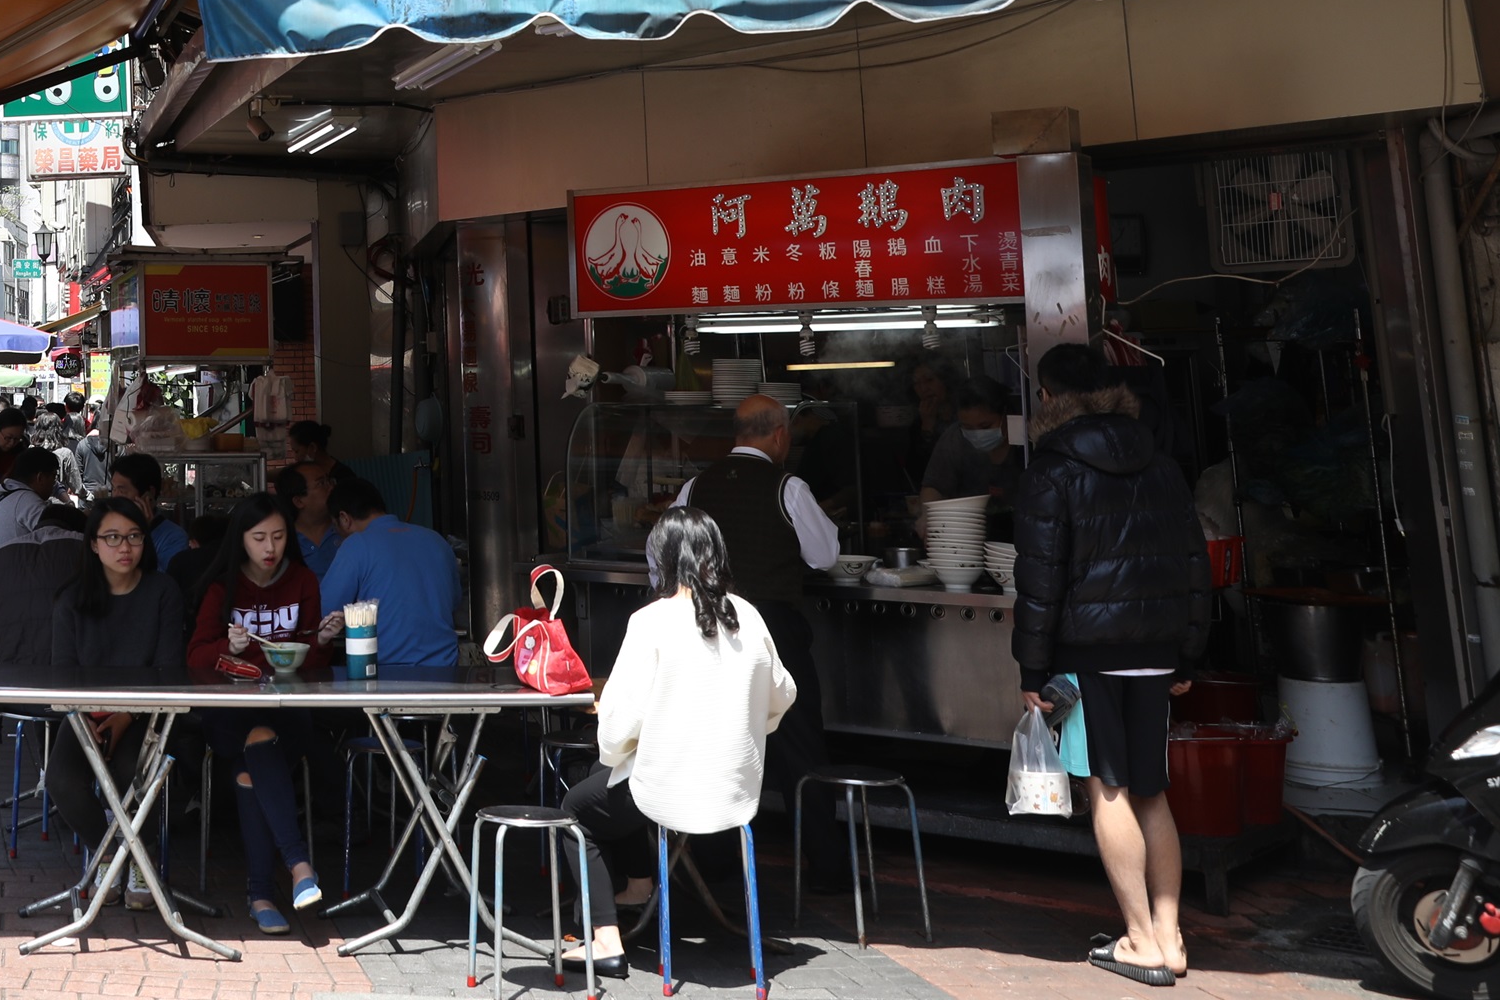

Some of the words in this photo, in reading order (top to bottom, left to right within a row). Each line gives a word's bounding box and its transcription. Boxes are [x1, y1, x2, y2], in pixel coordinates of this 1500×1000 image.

[34, 146, 121, 174] 榮昌藥局
[711, 176, 985, 239] 阿萬鵝肉
[753, 246, 772, 302] 米粉
[786, 243, 805, 300] 冬粉
[853, 239, 874, 298] 陽春麵
[960, 234, 983, 293] 下水湯
[187, 325, 209, 333] SINCE
[212, 325, 228, 333] 1962
